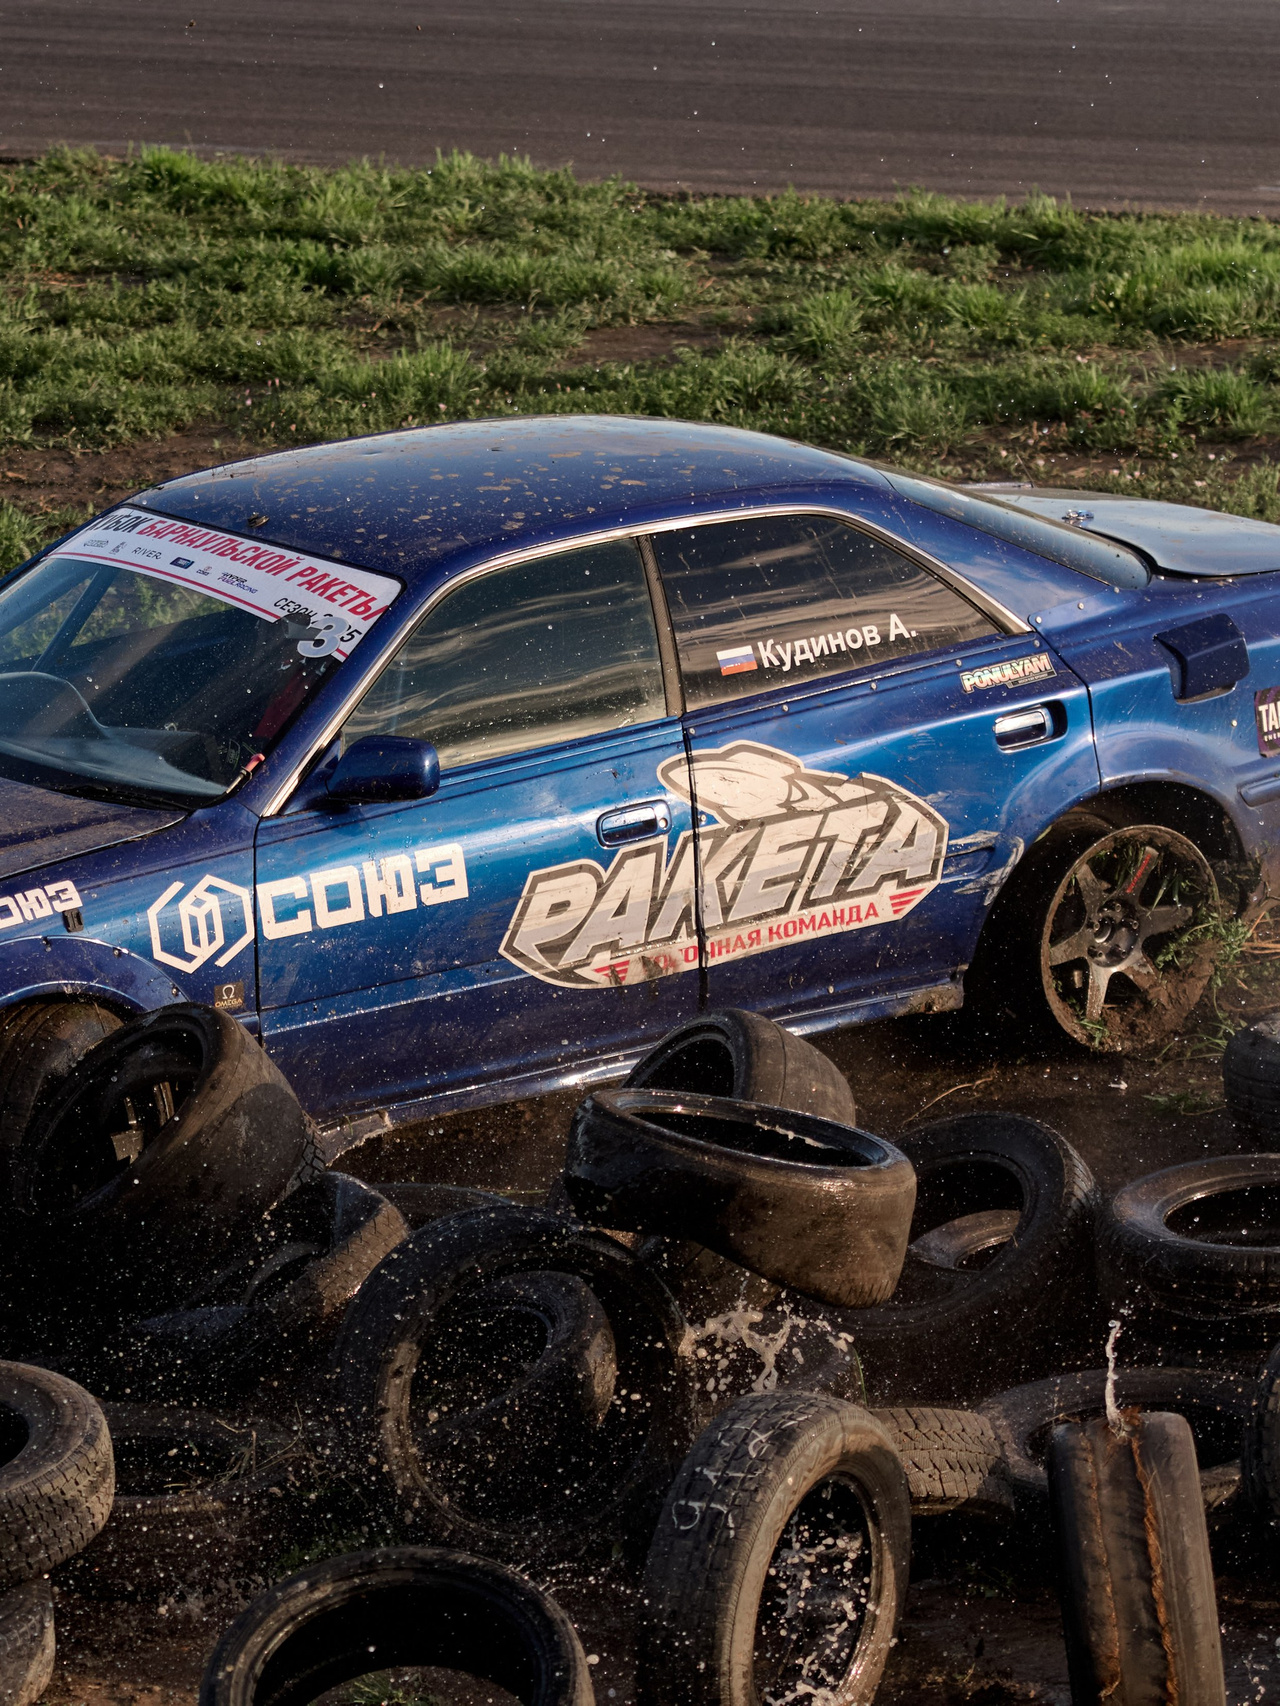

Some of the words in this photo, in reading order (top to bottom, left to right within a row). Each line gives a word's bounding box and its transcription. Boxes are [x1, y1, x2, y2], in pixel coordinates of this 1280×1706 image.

[131, 546, 162, 560] RIVER
[136, 520, 306, 577] БАРНАУЛЬСКОЙ
[285, 565, 390, 621] РАКЕТЫ
[757, 625, 881, 672] Кудинов
[889, 613, 918, 642] А.
[961, 654, 1052, 693] PONULYAM
[256, 842, 469, 941] СОЮЗ
[511, 792, 939, 973] РАКЕТА
[767, 901, 880, 941] КОМАНДА
[214, 997, 244, 1008] OMEGA
